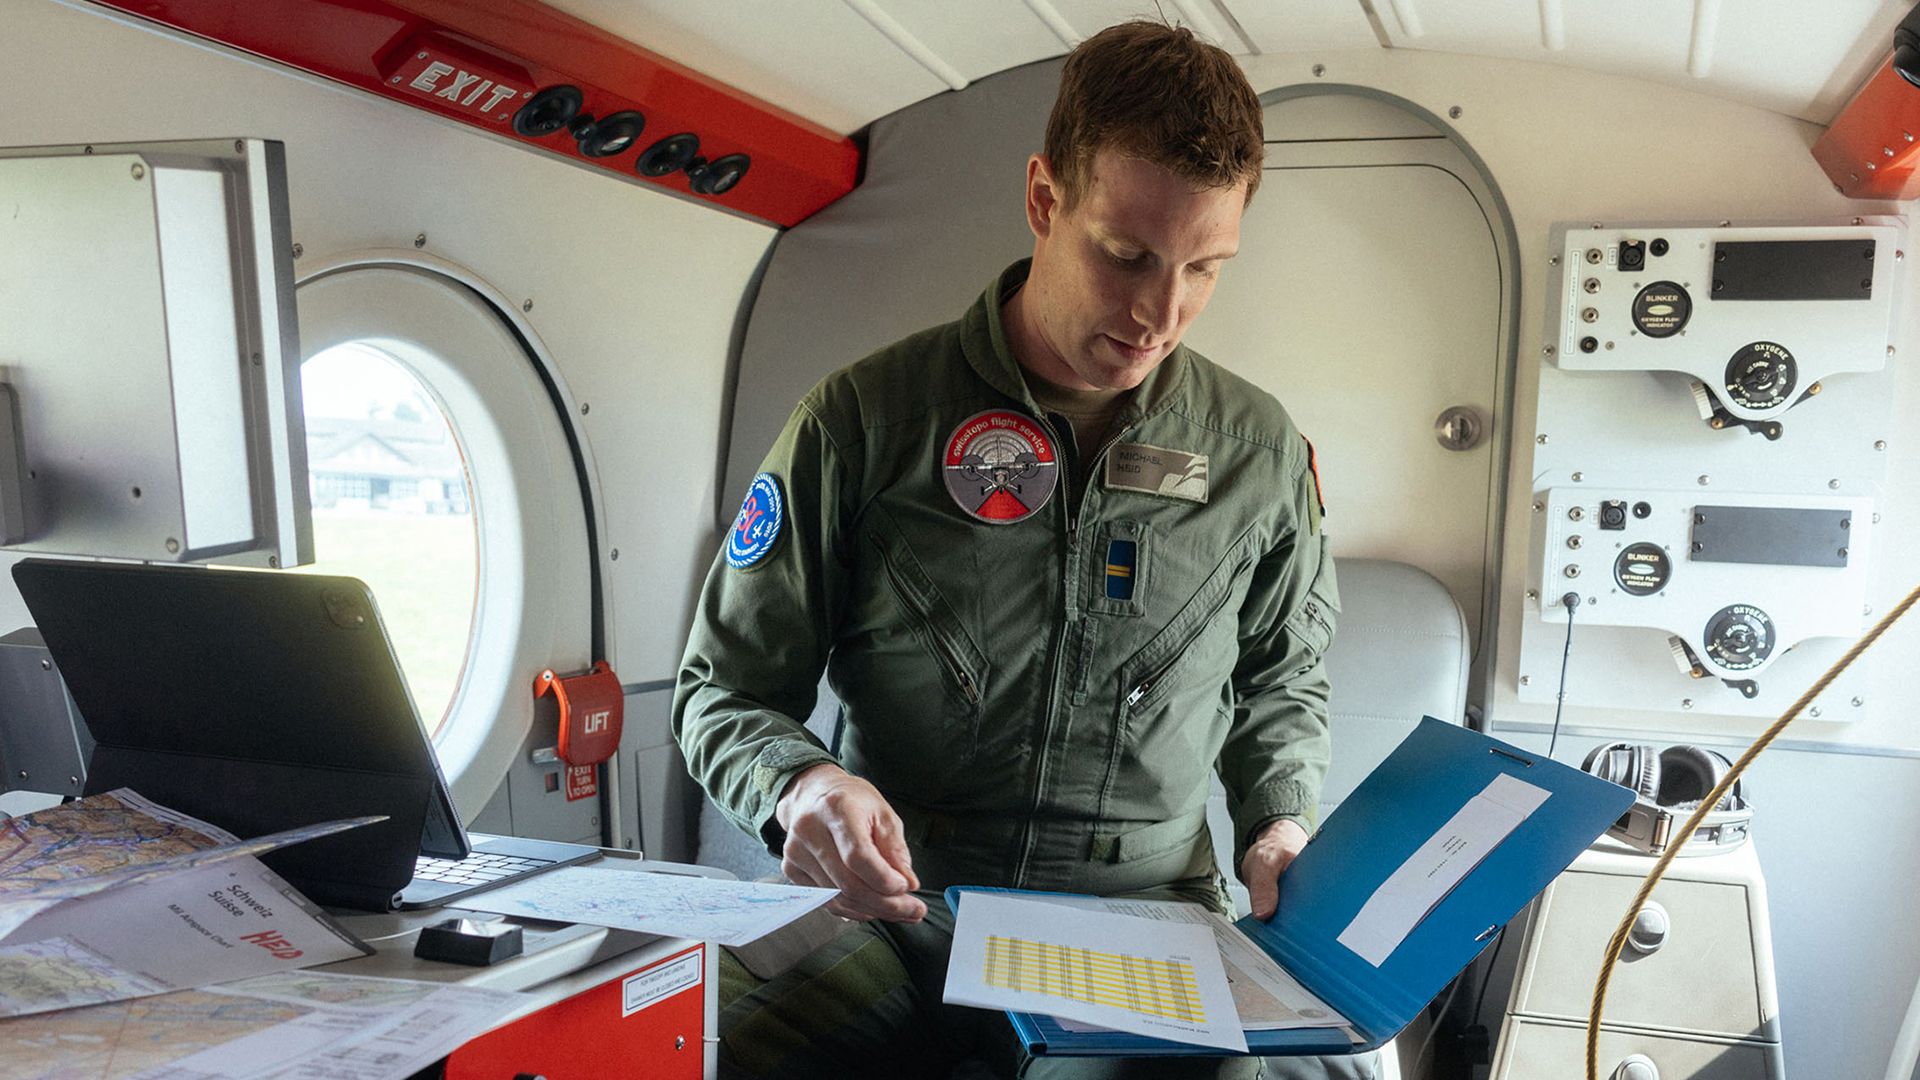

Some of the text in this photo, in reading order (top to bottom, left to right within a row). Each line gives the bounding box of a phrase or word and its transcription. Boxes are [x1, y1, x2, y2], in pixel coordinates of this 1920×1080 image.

[409, 60, 518, 113] EXIT
[1645, 294, 1679, 302] BLINKER
[1754, 343, 1789, 361] OXYGENE
[953, 420, 989, 457] swisstopo
[1020, 422, 1046, 454] service
[1119, 451, 1163, 466] MICHAEL
[1116, 463, 1141, 474] HEID
[1627, 552, 1660, 562] BLINKER
[584, 711, 609, 735] LIFT
[574, 765, 592, 777] EXIT
[576, 775, 592, 786] TURN
[208, 890, 244, 917] Suisse
[227, 884, 273, 919] Schweiz
